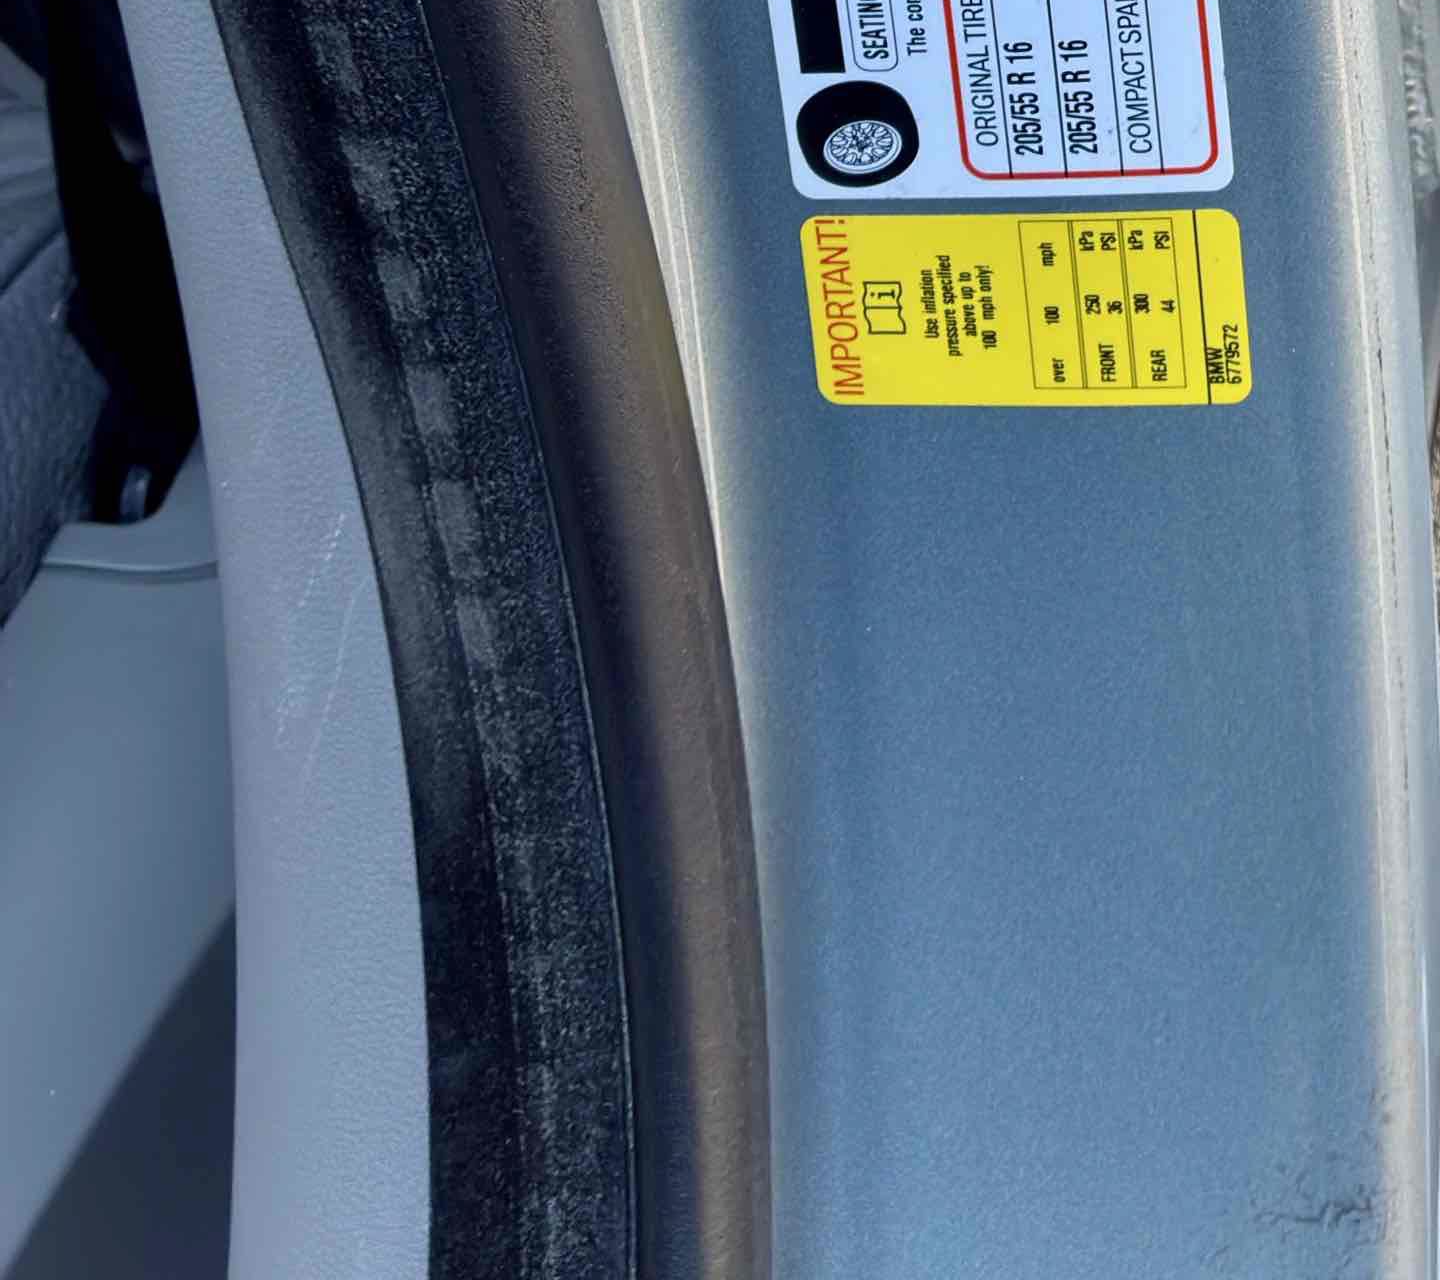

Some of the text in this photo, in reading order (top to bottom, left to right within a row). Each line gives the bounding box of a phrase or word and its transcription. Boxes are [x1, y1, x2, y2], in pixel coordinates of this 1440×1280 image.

[906, 28, 927, 56] The
[966, 46, 999, 146] ORIGINAL
[1003, 42, 1044, 155] 205/55 R 16
[1058, 40, 1098, 154] 205/55 R 16
[1120, 48, 1152, 154] COMPACT
[814, 219, 864, 396] IMPORTANT!
[920, 269, 939, 339] Use inflation
[936, 255, 962, 357] pressure specified
[958, 272, 977, 336] above up to
[975, 265, 997, 350] 100 mph only!
[1038, 242, 1066, 383] over 100 mph
[1078, 231, 1117, 382] FRONT 250 kPa
[1100, 232, 1122, 314] 36 PSI
[1128, 230, 1168, 382] REAR 300 kPa
[1154, 231, 1175, 313] 44 PSI
[1207, 347, 1225, 384] BMW
[1223, 324, 1242, 384] 6779572
